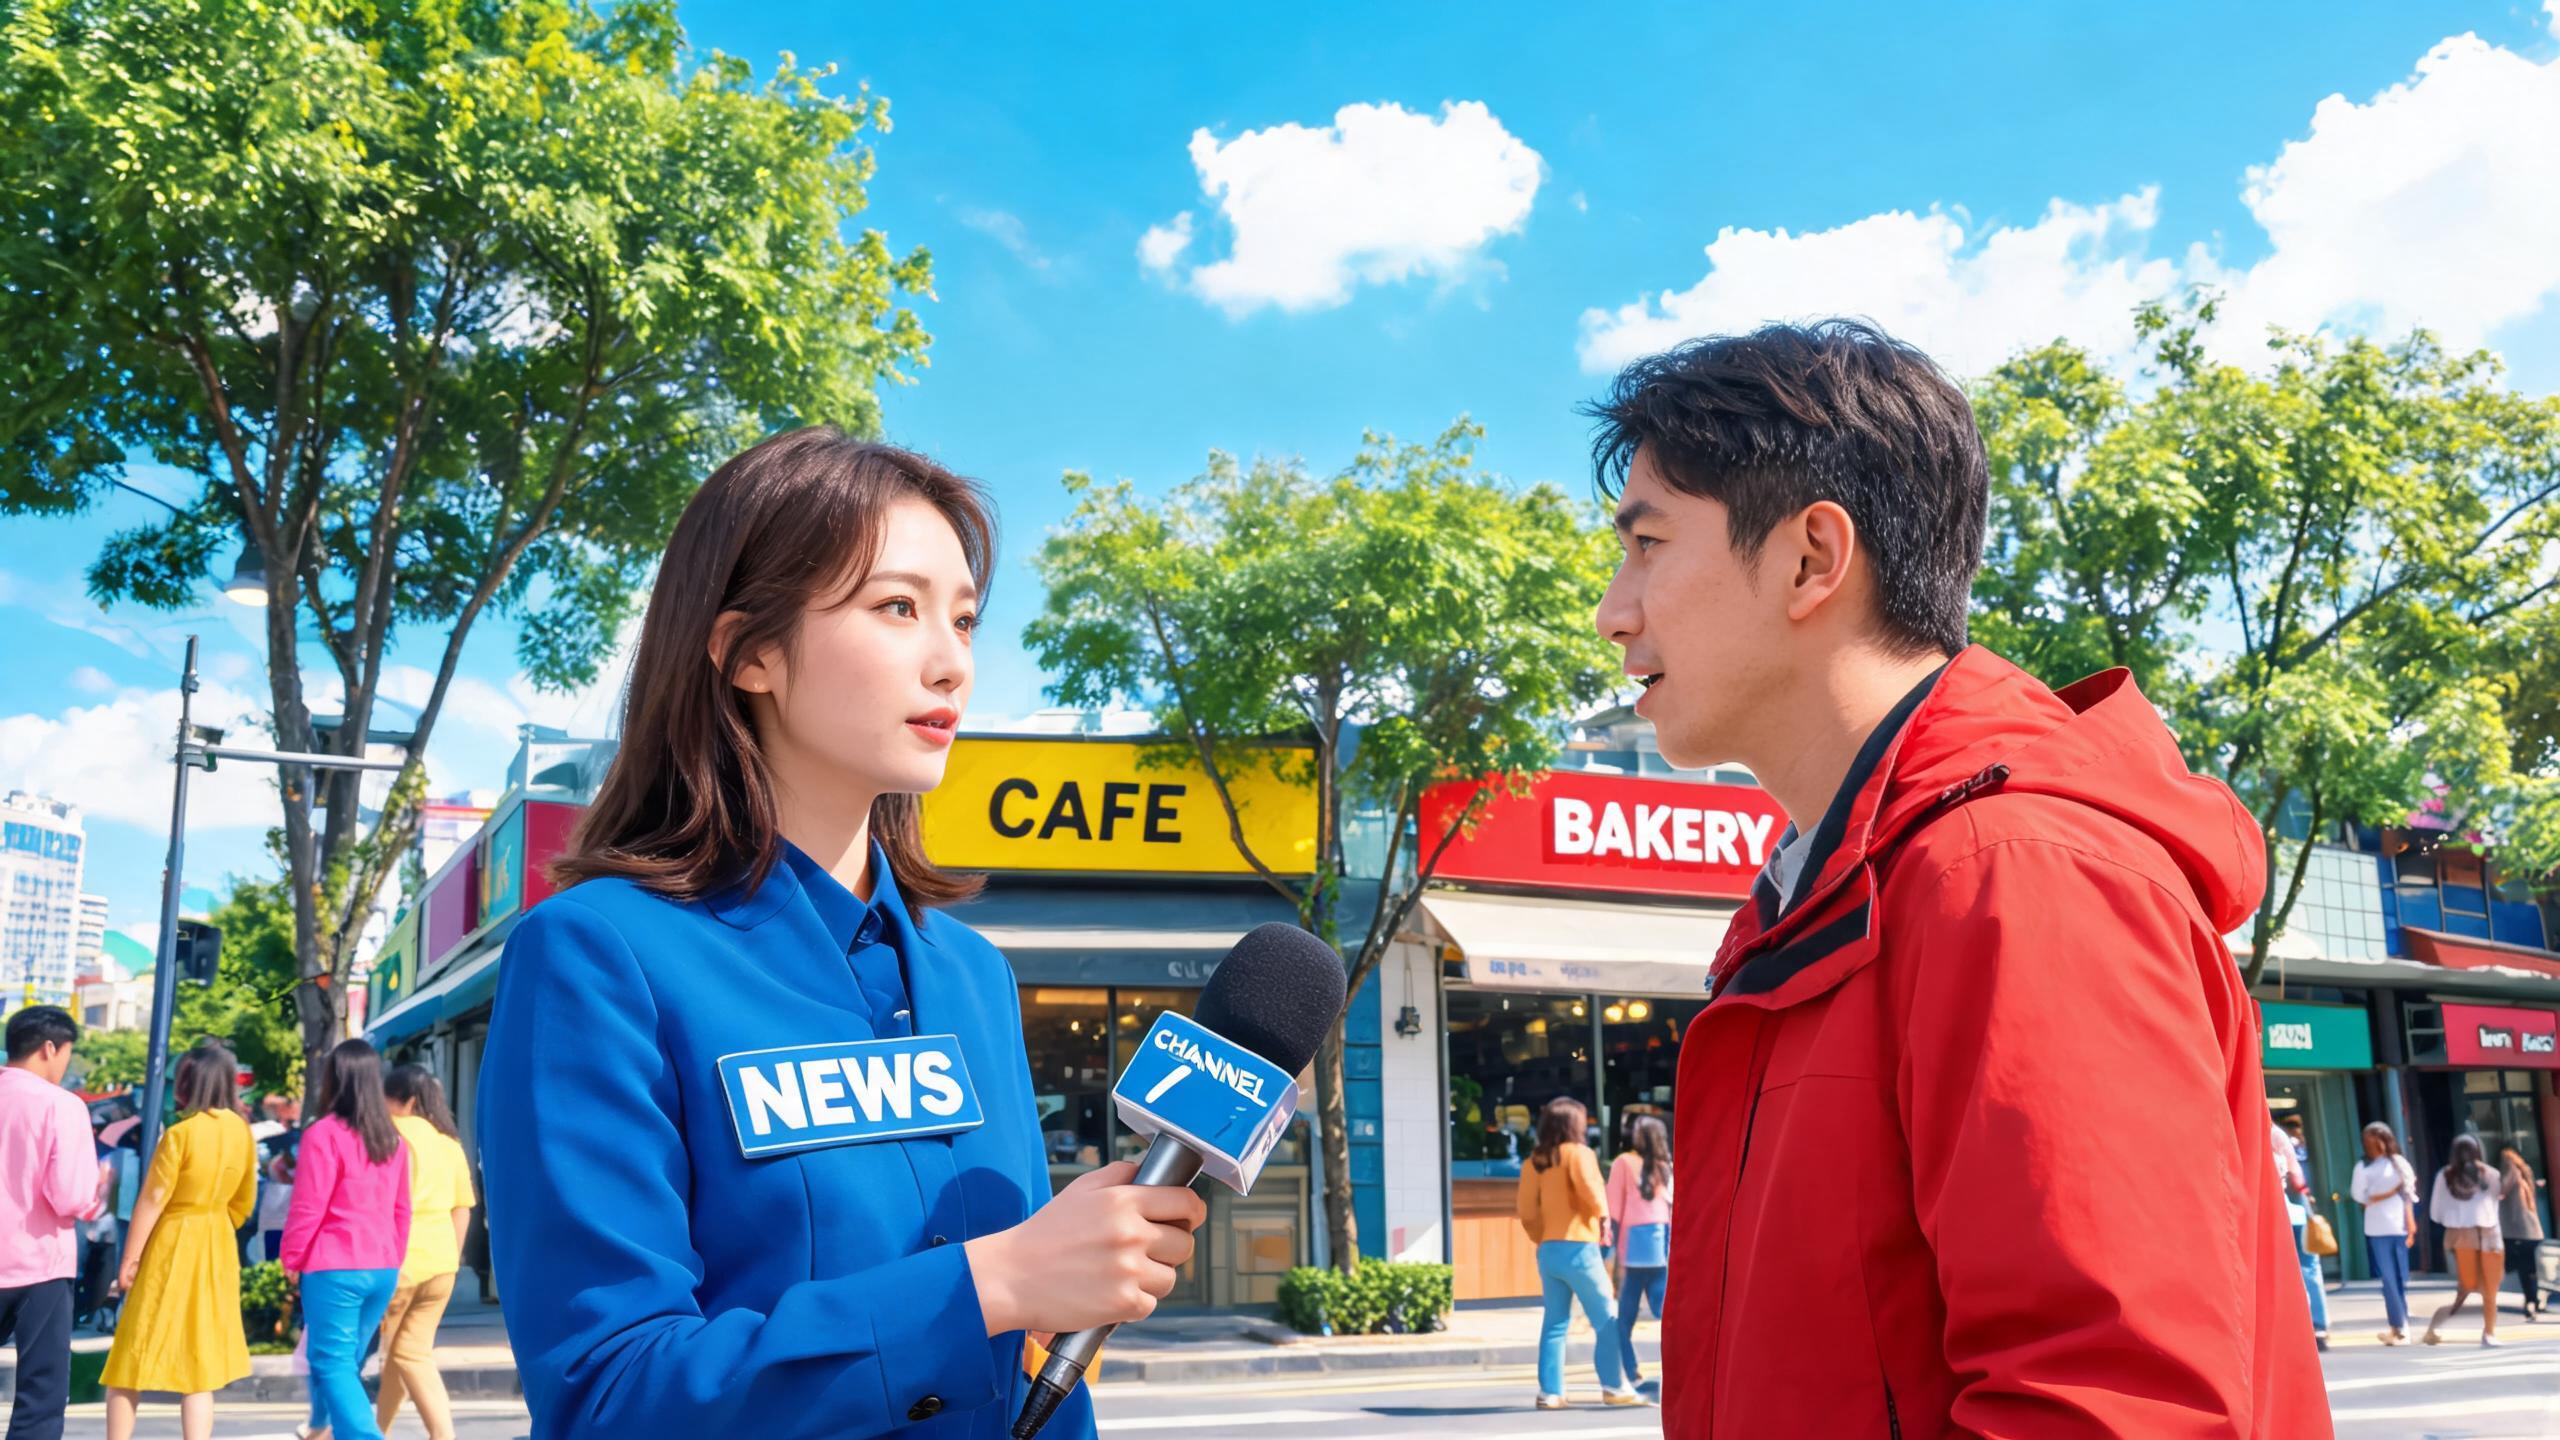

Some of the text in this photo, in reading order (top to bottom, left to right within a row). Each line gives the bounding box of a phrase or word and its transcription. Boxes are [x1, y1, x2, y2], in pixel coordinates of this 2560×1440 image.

[989, 778, 1187, 843] CAFE
[1553, 797, 1774, 866] BAKERY
[738, 1050, 964, 1136] NEWS
[1154, 1029, 1268, 1108] CHANNEL
